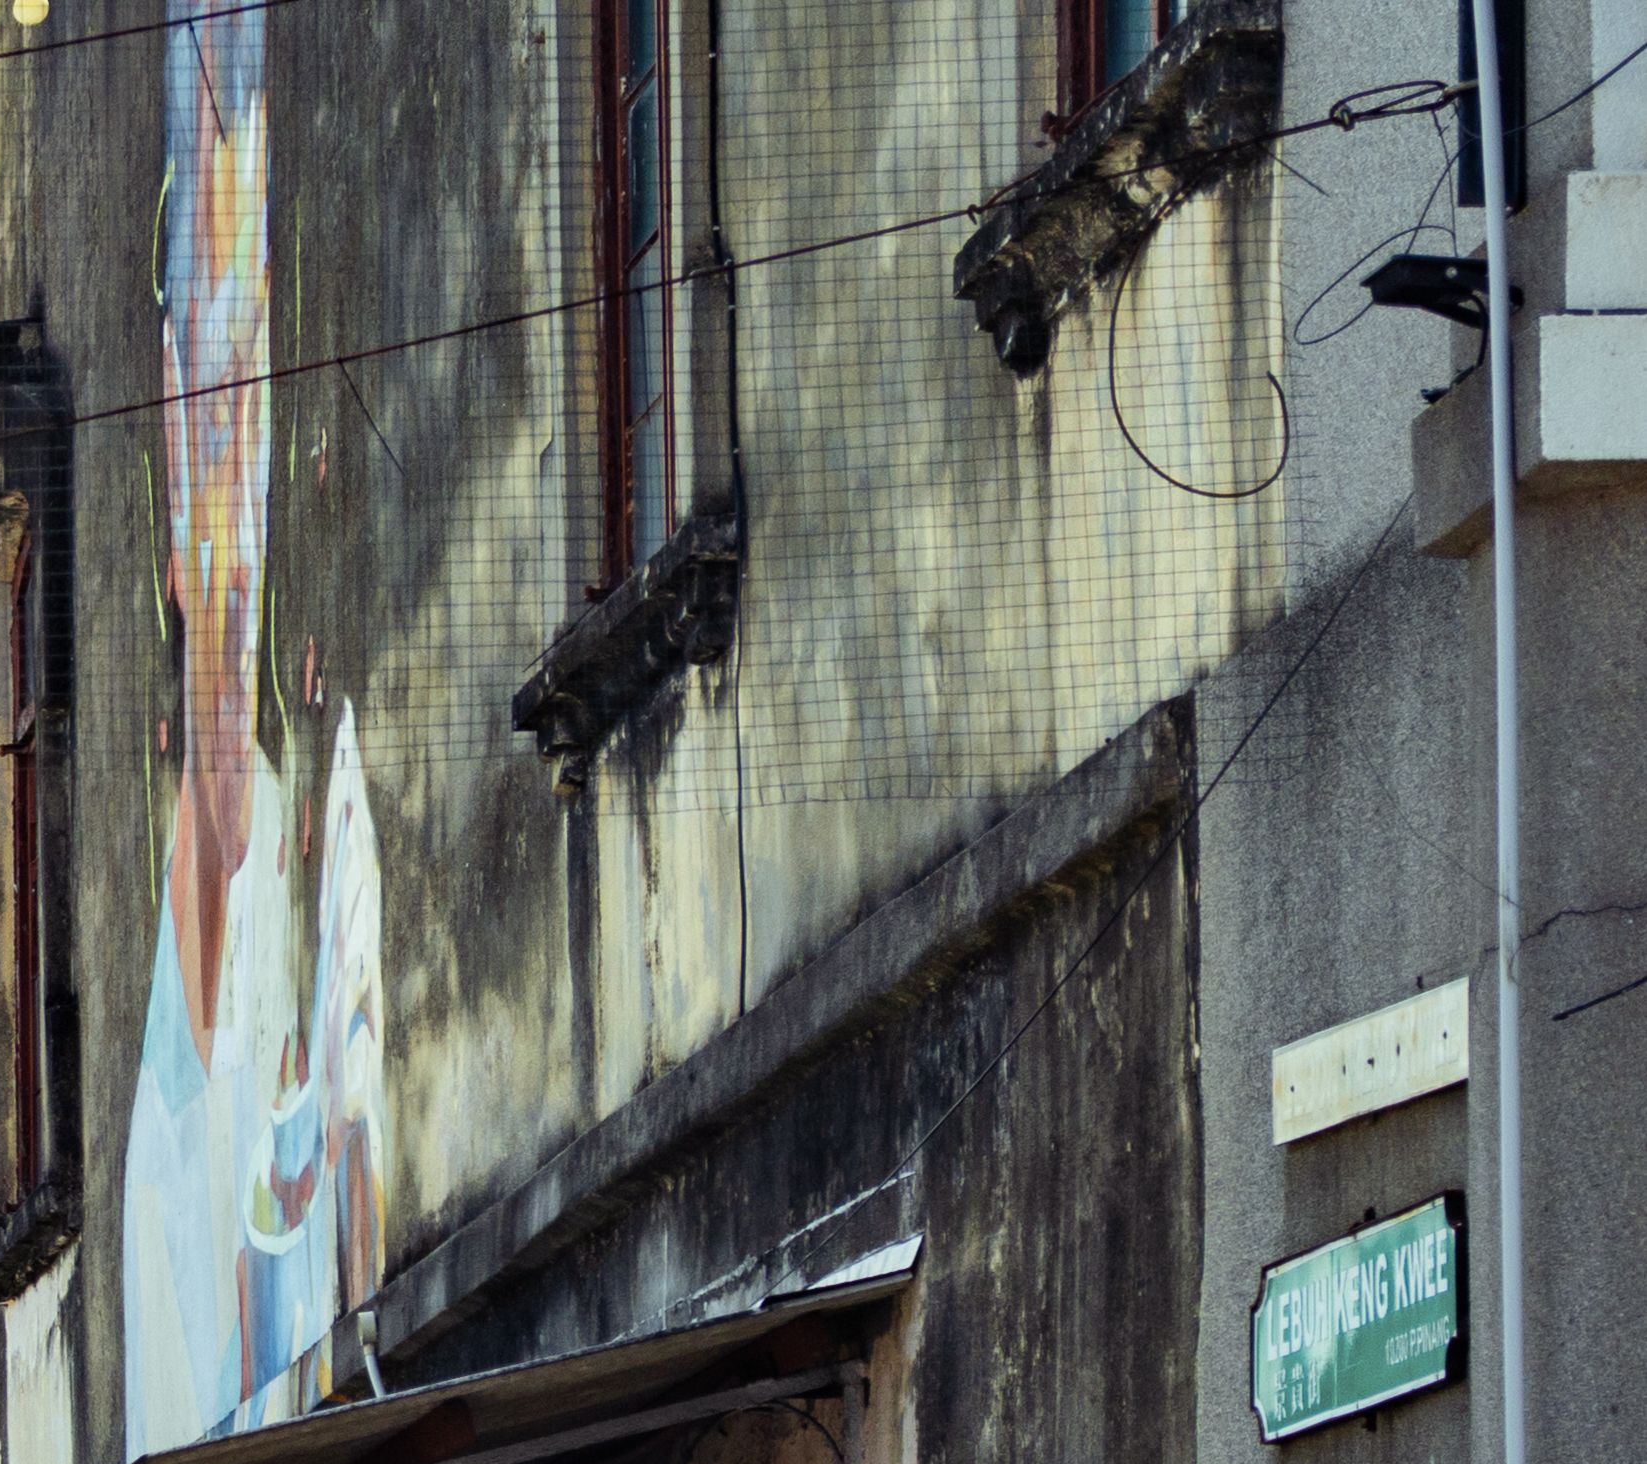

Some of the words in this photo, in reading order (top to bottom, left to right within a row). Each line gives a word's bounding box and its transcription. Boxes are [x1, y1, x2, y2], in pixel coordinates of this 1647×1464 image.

[1265, 1268, 1332, 1360] LEBUH
[1332, 1252, 1388, 1335] KENG
[1393, 1227, 1449, 1312] KWEE
